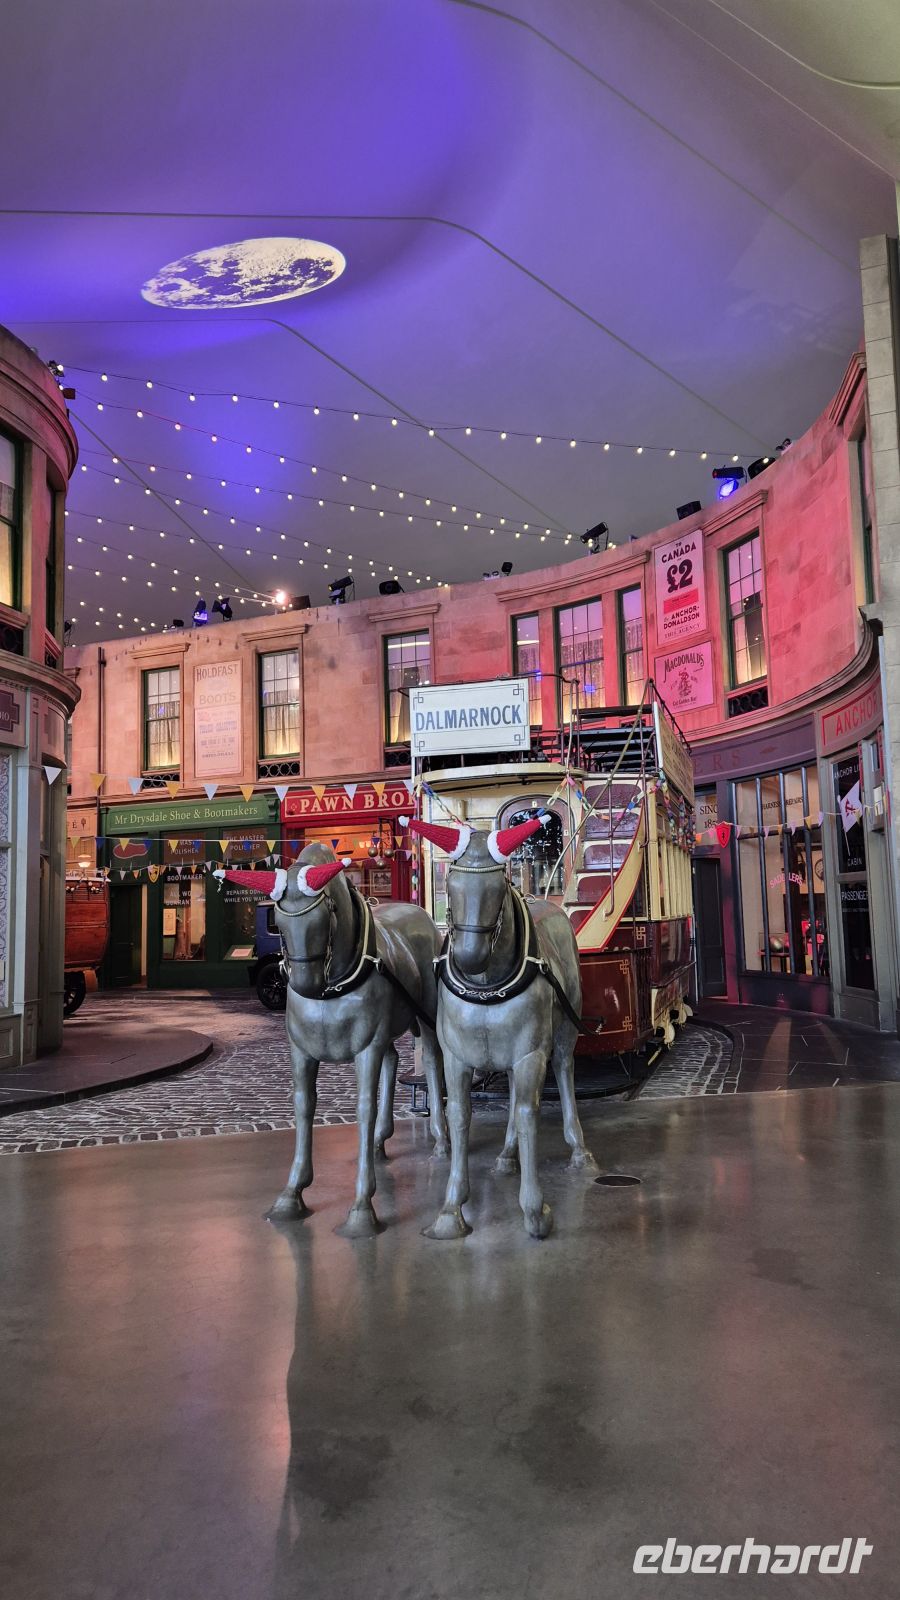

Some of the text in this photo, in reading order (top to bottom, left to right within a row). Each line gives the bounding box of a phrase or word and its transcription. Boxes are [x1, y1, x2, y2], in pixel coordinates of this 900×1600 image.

[661, 542, 697, 563] CANADA
[666, 559, 693, 593] £2
[663, 612, 700, 630] DONALDSON
[671, 605, 700, 620] ANCHOR-
[196, 664, 239, 682] HOLDFAST
[200, 691, 236, 705] BOOTS
[415, 704, 522, 731] DALMARNOCK
[300, 795, 355, 813] PAWN
[699, 804, 718, 815] SINC
[114, 805, 258, 826] Mr Drysdale Shoe & Bootmakers
[847, 857, 862, 867] CABIN
